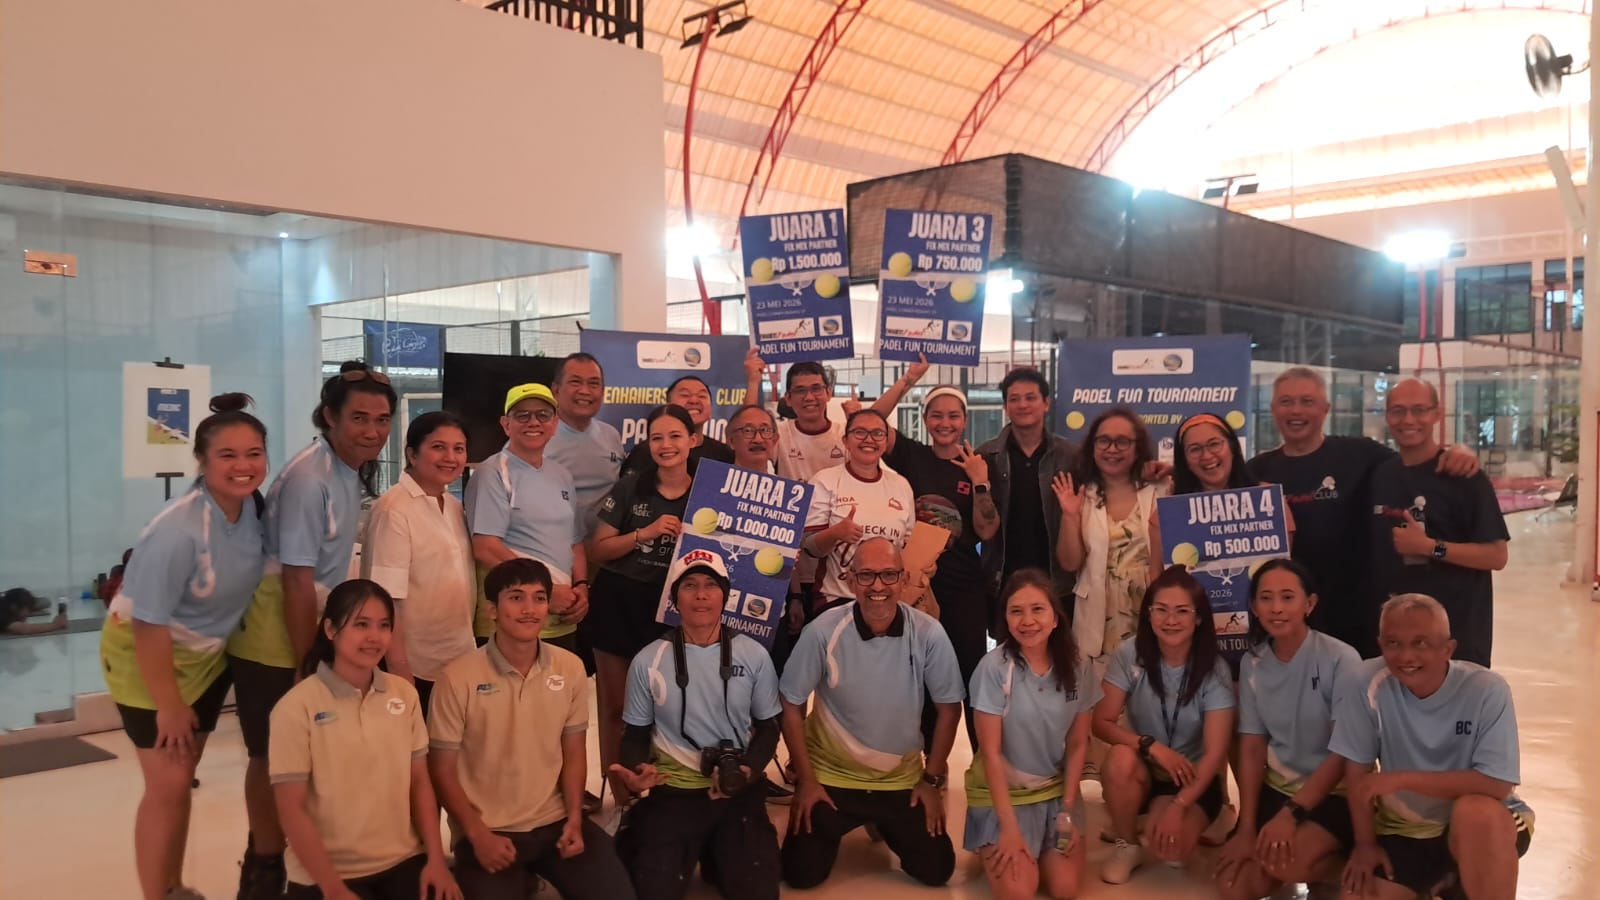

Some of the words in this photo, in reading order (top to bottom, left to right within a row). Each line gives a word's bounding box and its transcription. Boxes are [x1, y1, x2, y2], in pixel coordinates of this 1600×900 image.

[769, 212, 827, 242] JUARA
[829, 211, 839, 237] 1
[908, 212, 967, 241] JUARA
[971, 216, 985, 242] 3
[784, 242, 795, 252] FIX
[795, 241, 808, 251] MIX
[808, 239, 838, 250] PARTNER
[925, 241, 937, 250] FIX
[937, 242, 950, 251] MIX
[951, 243, 981, 253] PARTNER
[771, 257, 786, 272] Rp
[788, 252, 842, 270] 1.500.000
[918, 254, 933, 271] Rp
[935, 255, 983, 272] 750.000
[756, 302, 766, 310] 23
[767, 300, 782, 309] MEI
[783, 299, 802, 308] 2026
[887, 296, 897, 304] 23
[898, 297, 913, 305] MEI
[914, 298, 934, 307] 2026
[759, 344, 779, 355] ADEL
[780, 343, 797, 353] FUN
[798, 338, 850, 352] TOURNAMENT
[880, 339, 902, 352] PADEL
[904, 342, 921, 353] FUN
[922, 343, 976, 356] TOURNAMENT
[1072, 387, 1113, 404] PADEL
[1117, 387, 1143, 403] FUN
[1147, 386, 1238, 403] TOURNAMENT
[1170, 414, 1183, 425] BY
[720, 468, 786, 509] JUARA
[786, 484, 805, 512] 2
[736, 501, 749, 512] FIX
[749, 503, 763, 516] MIX
[763, 507, 796, 525] PARTNER
[1188, 491, 1255, 525] JUARA
[1260, 489, 1275, 518] 4
[717, 511, 733, 530] Rp
[736, 516, 795, 544] 1.000.000
[890, 528, 900, 537] IN
[1210, 525, 1222, 536] FIX
[1223, 523, 1238, 535] MIX
[1239, 520, 1274, 533] PARTNER
[1204, 540, 1221, 558] Rp
[1225, 535, 1280, 554] 500.000
[1210, 589, 1233, 598] 2026
[1456, 720, 1472, 736] BC
